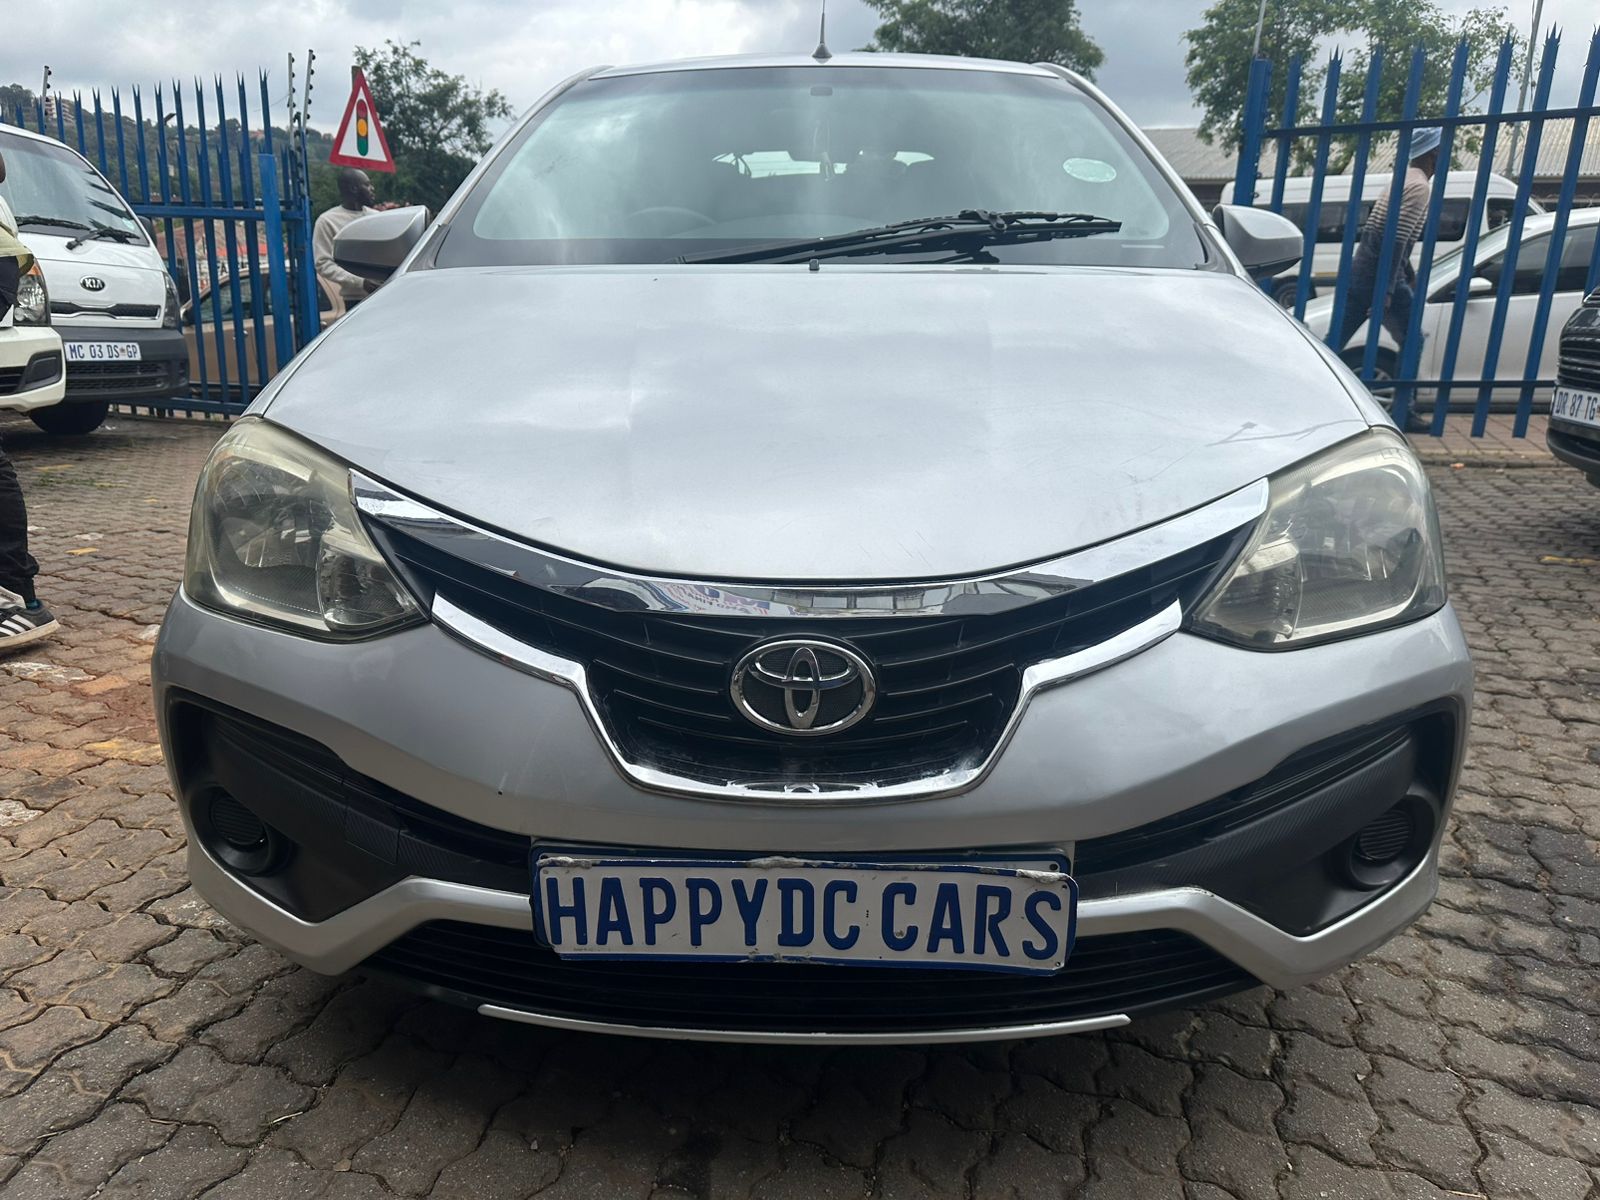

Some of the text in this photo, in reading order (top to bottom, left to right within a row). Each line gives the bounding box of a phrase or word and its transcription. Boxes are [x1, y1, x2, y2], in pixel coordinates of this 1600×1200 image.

[84, 278, 103, 288] KIA
[69, 344, 137, 359] MC 03 DS GP
[1555, 391, 1598, 420] DR 87 TG
[546, 876, 1062, 960] HAPPYDC CARS
